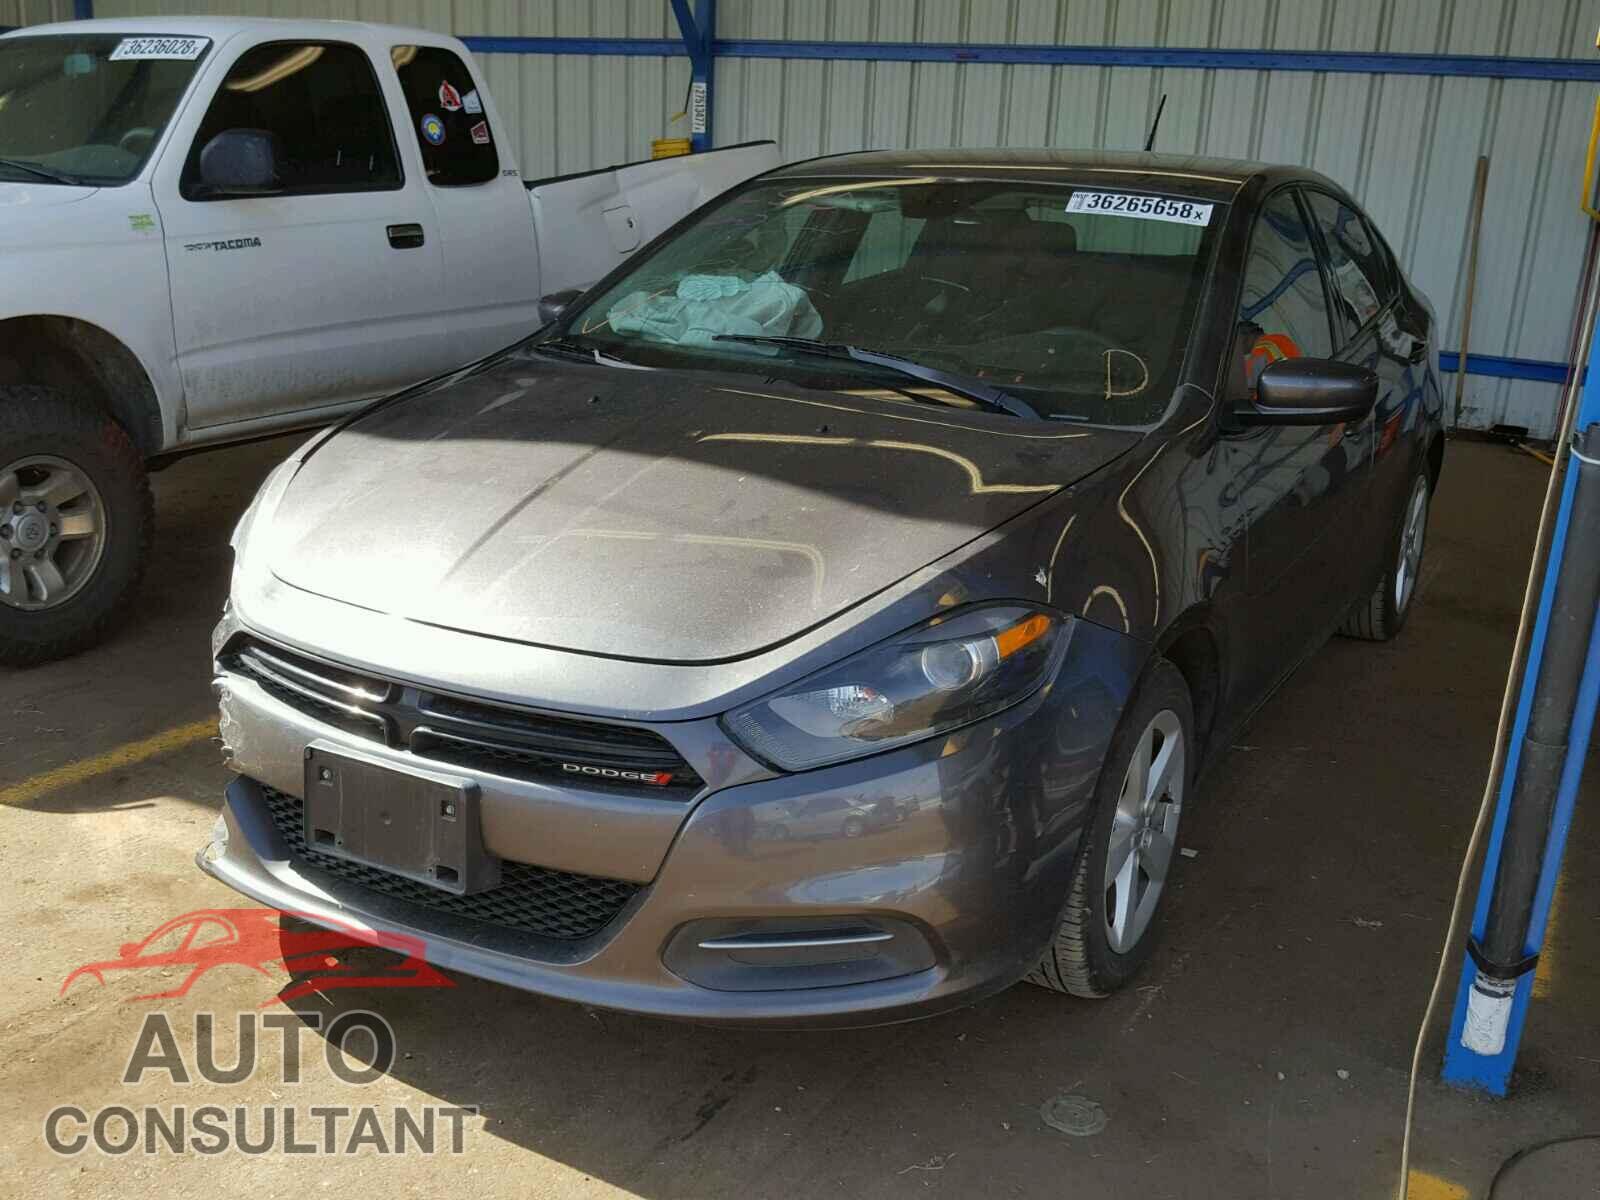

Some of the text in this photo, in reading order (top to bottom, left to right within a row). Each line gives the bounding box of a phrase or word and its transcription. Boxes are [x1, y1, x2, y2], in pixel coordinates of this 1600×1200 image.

[213, 237, 262, 251] TACOMA
[1102, 349, 1149, 400] D
[562, 763, 657, 782] DODGE
